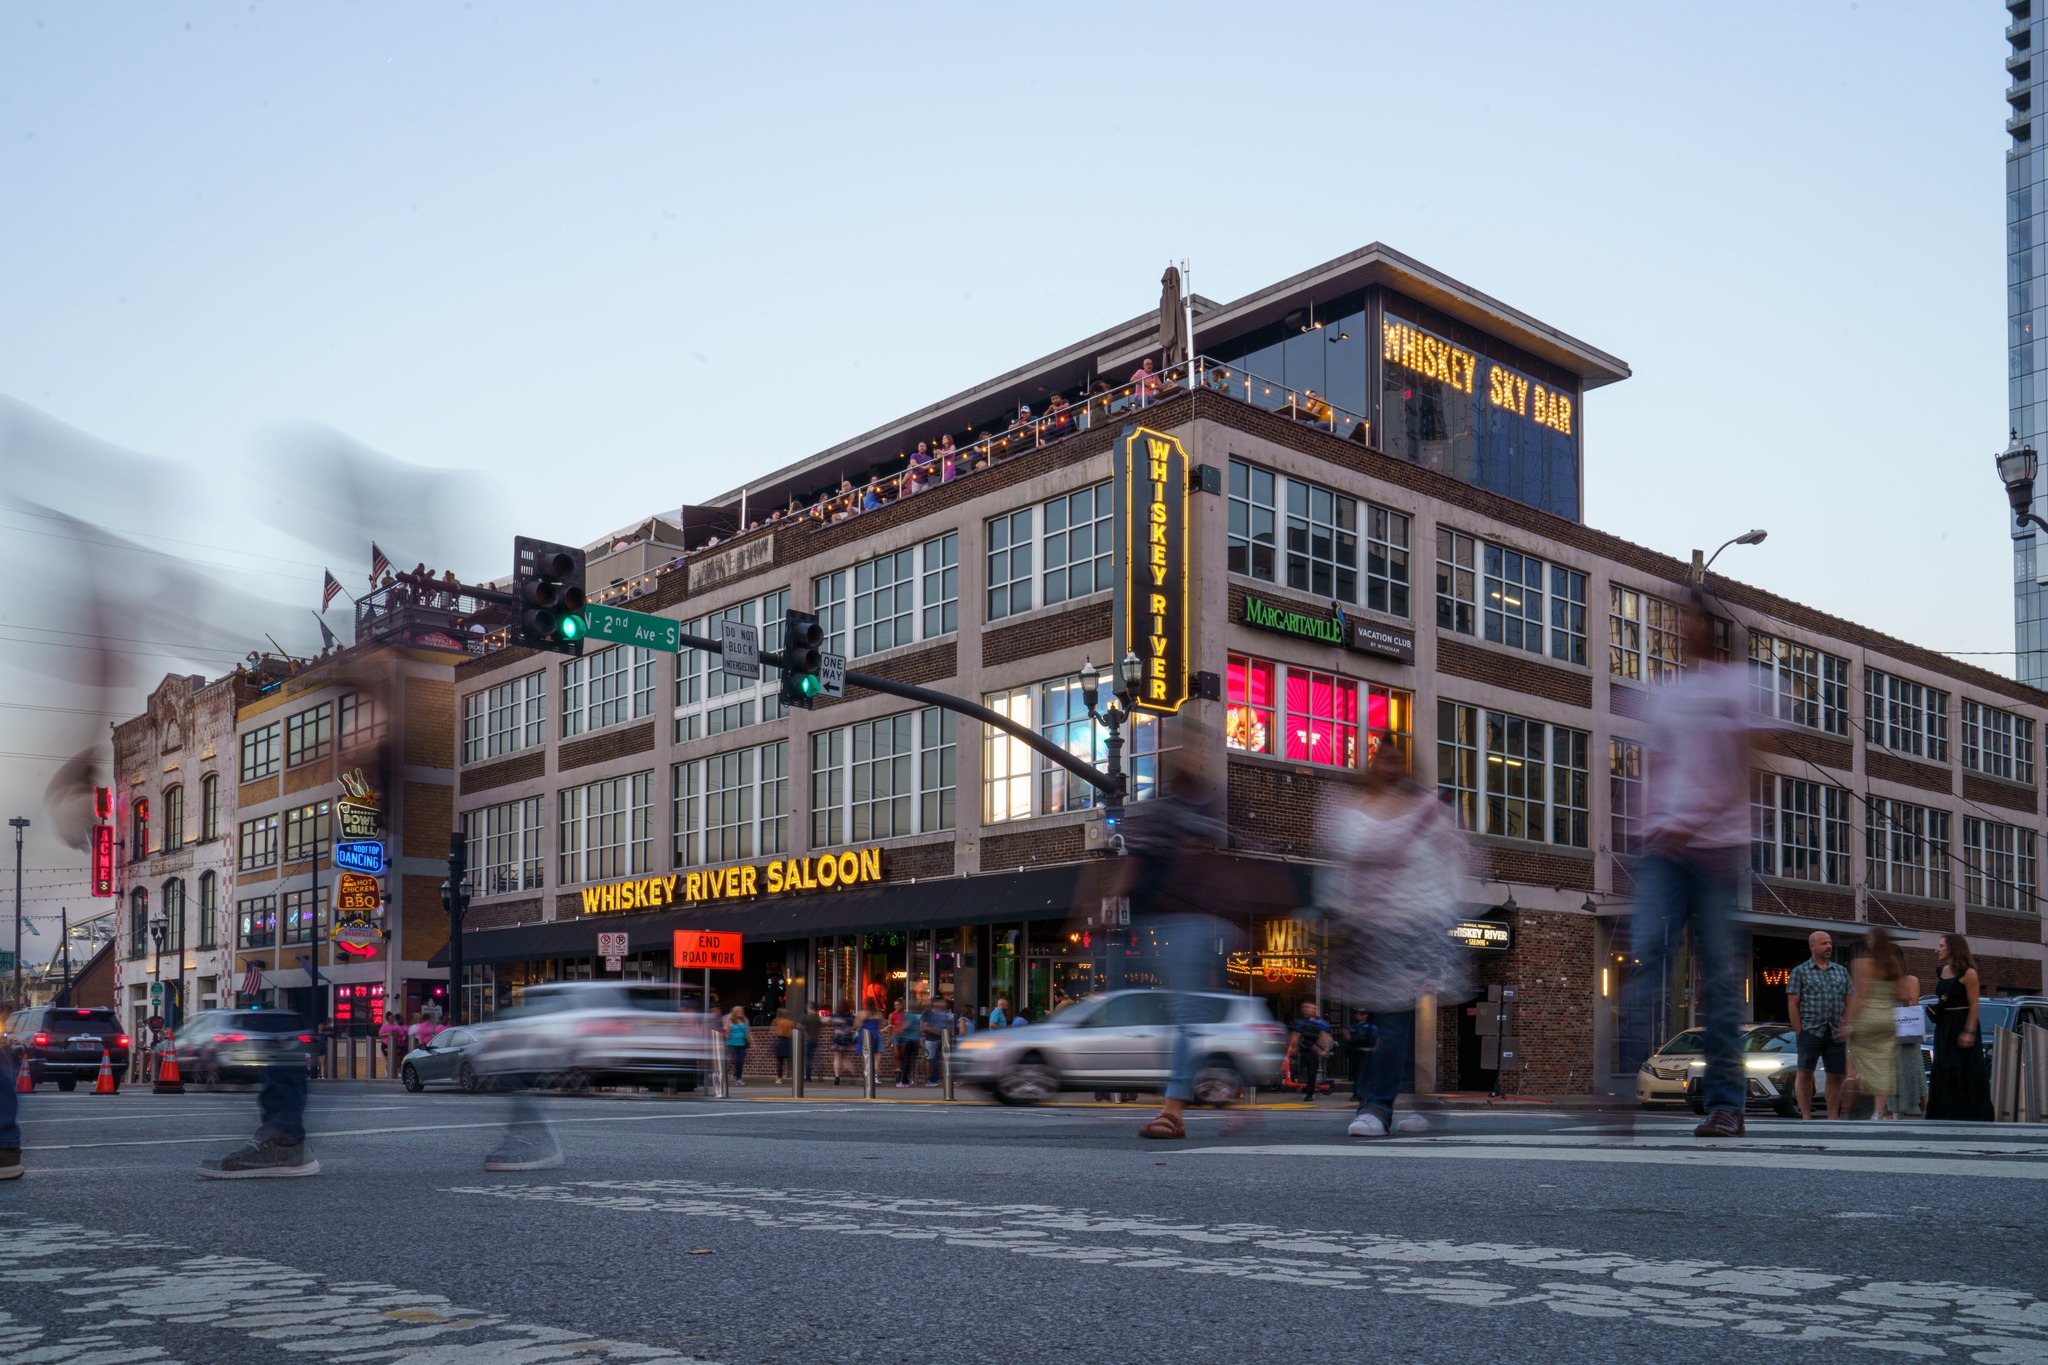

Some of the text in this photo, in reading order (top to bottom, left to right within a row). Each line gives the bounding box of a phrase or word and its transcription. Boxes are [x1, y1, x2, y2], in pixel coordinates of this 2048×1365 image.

[1383, 317, 1571, 436] WHISKEY SKY BAR
[1147, 438, 1171, 701] WHISKEY RIVER
[1246, 596, 1343, 643] MARGARITAVILLE
[603, 615, 628, 633] 2nd
[635, 625, 656, 641] Ave
[666, 627, 675, 645] S
[726, 626, 754, 642] DO NOT
[1358, 627, 1412, 648] VACATION CLUB
[728, 641, 754, 656] BLOCK
[1377, 644, 1400, 653] WYNDHAM
[725, 659, 758, 673] INTERSECTION
[823, 656, 843, 670] ONE
[822, 668, 843, 681] WAY
[343, 814, 377, 827] BOWL
[100, 829, 109, 880] ACME
[353, 844, 379, 855] ROOFTOP
[339, 850, 379, 869] DANCING
[581, 847, 882, 914] WHISKEY RIVER SALOON
[342, 885, 375, 893] CHICKEN
[345, 895, 376, 908] BBQ
[699, 935, 720, 948] END
[1484, 929, 1508, 941] RIVER
[682, 951, 735, 964] ROAD WORK
